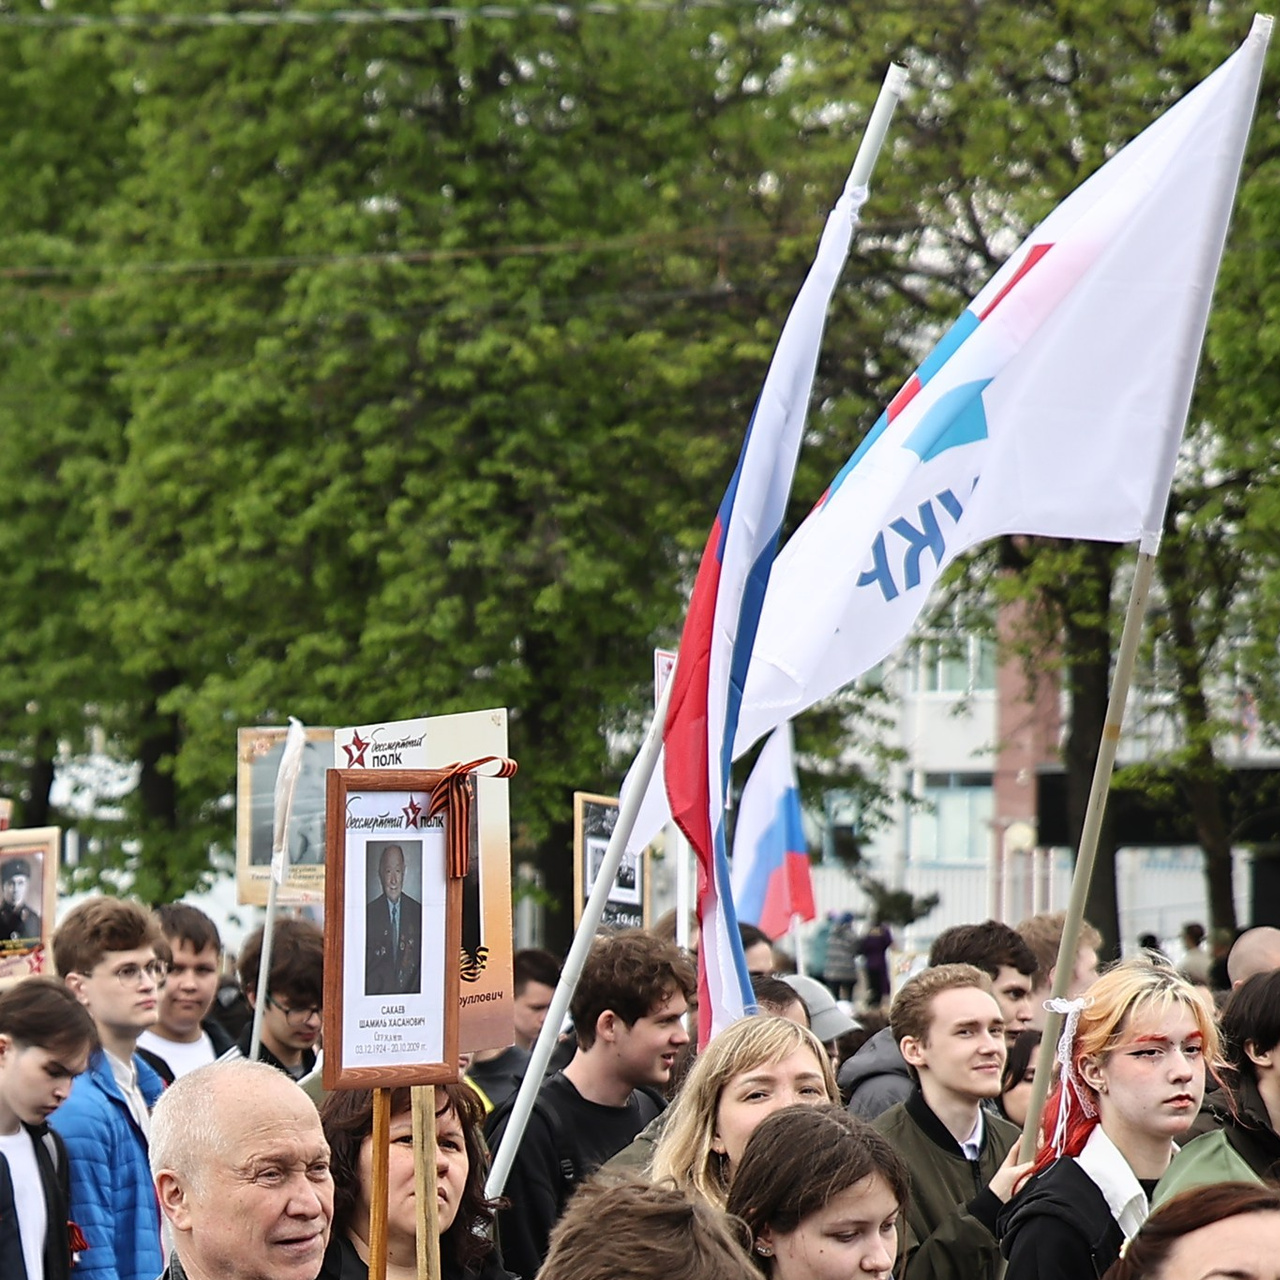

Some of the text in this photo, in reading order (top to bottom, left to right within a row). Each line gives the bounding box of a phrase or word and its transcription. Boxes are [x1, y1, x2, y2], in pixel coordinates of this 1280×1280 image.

[372, 753, 402, 768] ПОЛК
[381, 1005, 405, 1015] САКАЕВ
[359, 1017, 425, 1029] ШАМИЛЬ ХАСАНОВИЧ
